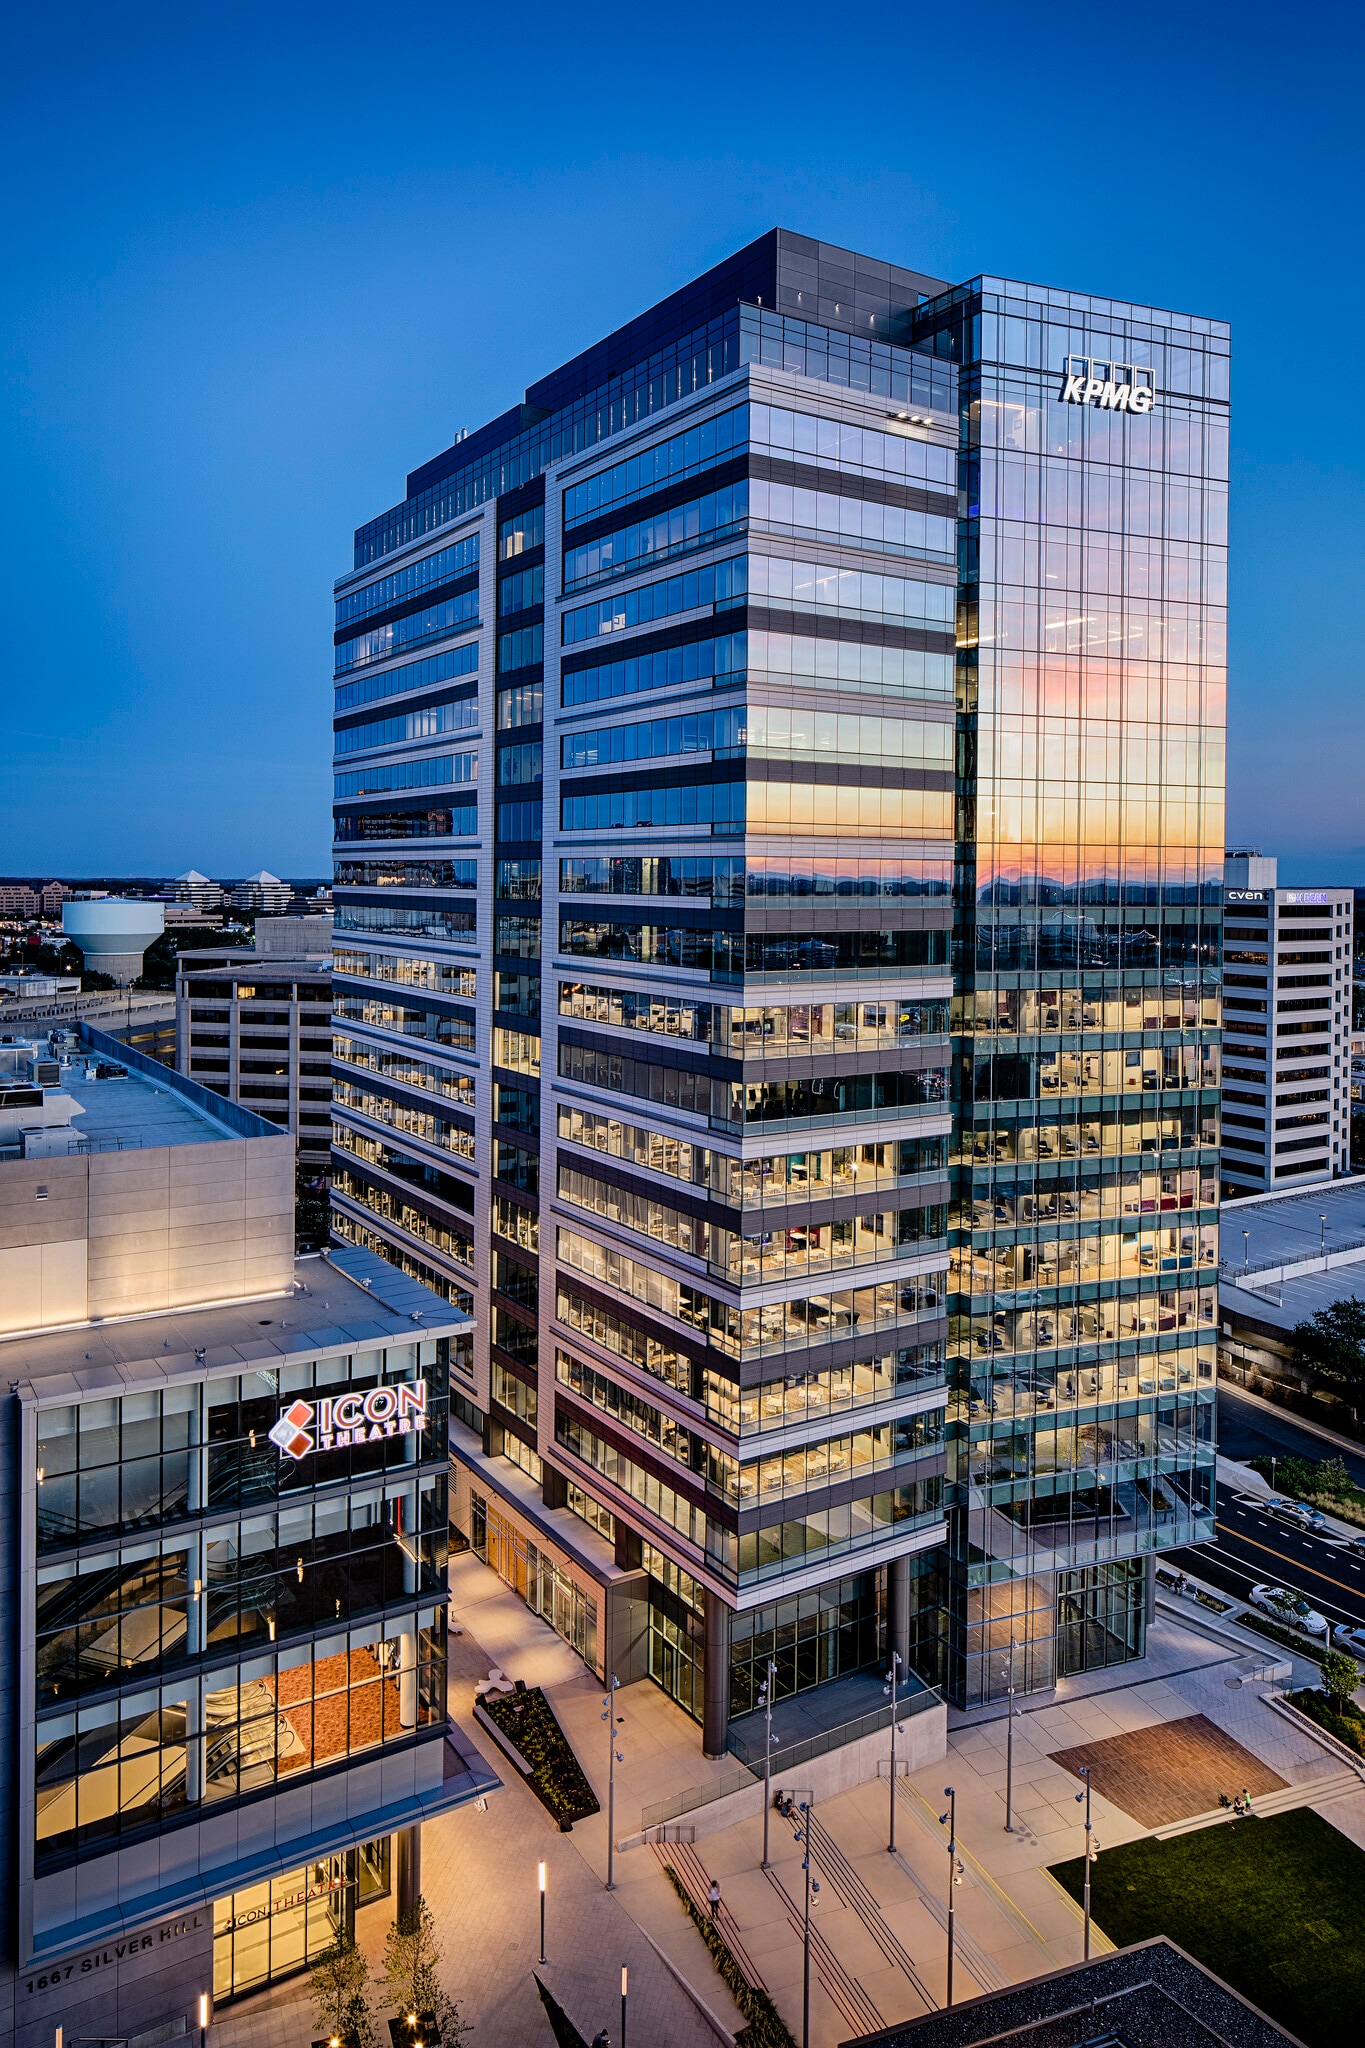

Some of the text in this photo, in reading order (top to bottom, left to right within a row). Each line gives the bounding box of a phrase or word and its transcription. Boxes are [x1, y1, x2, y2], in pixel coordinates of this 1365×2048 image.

[1063, 375, 1153, 413] KPMG
[320, 1379, 426, 1434] ICON
[320, 1414, 426, 1451] THEATRE
[233, 1873, 348, 1928] ICON THEATRE
[25, 1916, 203, 1994] 1667 SILVER HILL
